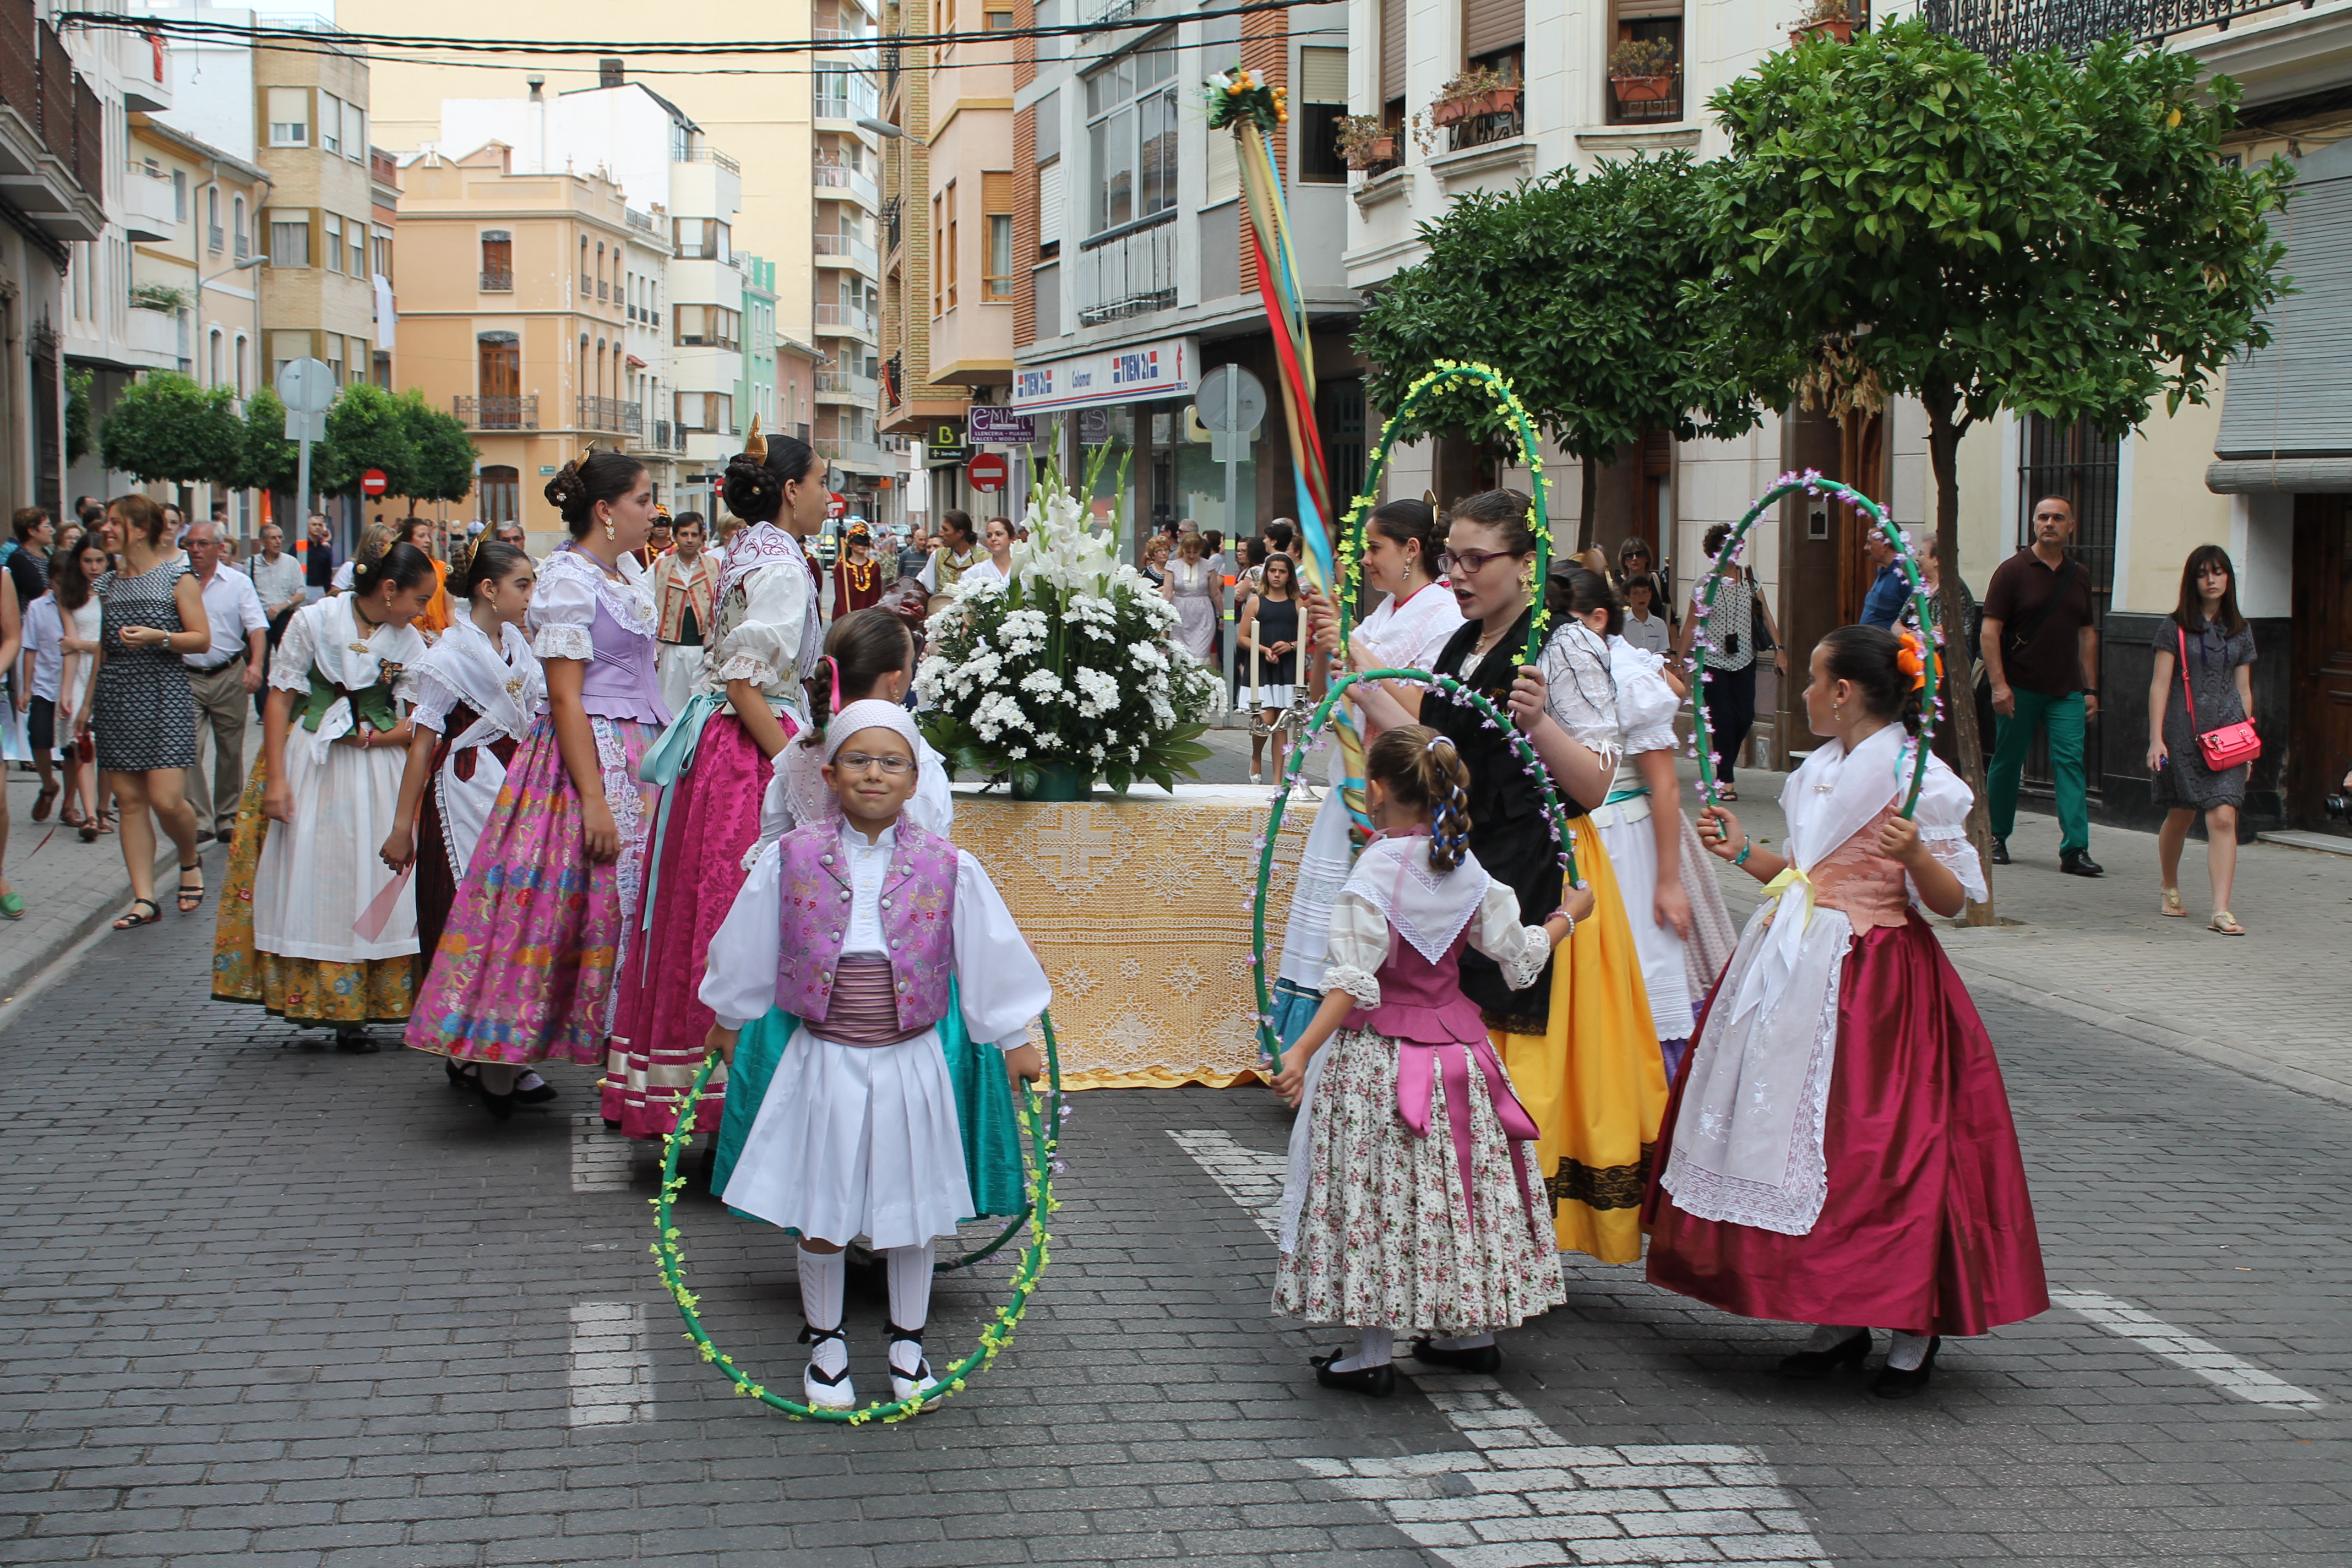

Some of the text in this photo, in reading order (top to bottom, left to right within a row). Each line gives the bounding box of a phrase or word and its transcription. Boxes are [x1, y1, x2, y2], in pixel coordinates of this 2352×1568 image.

[1121, 354, 1140, 382] TIEN
[1025, 372, 1039, 396] TIEN
[939, 426, 954, 444] B
